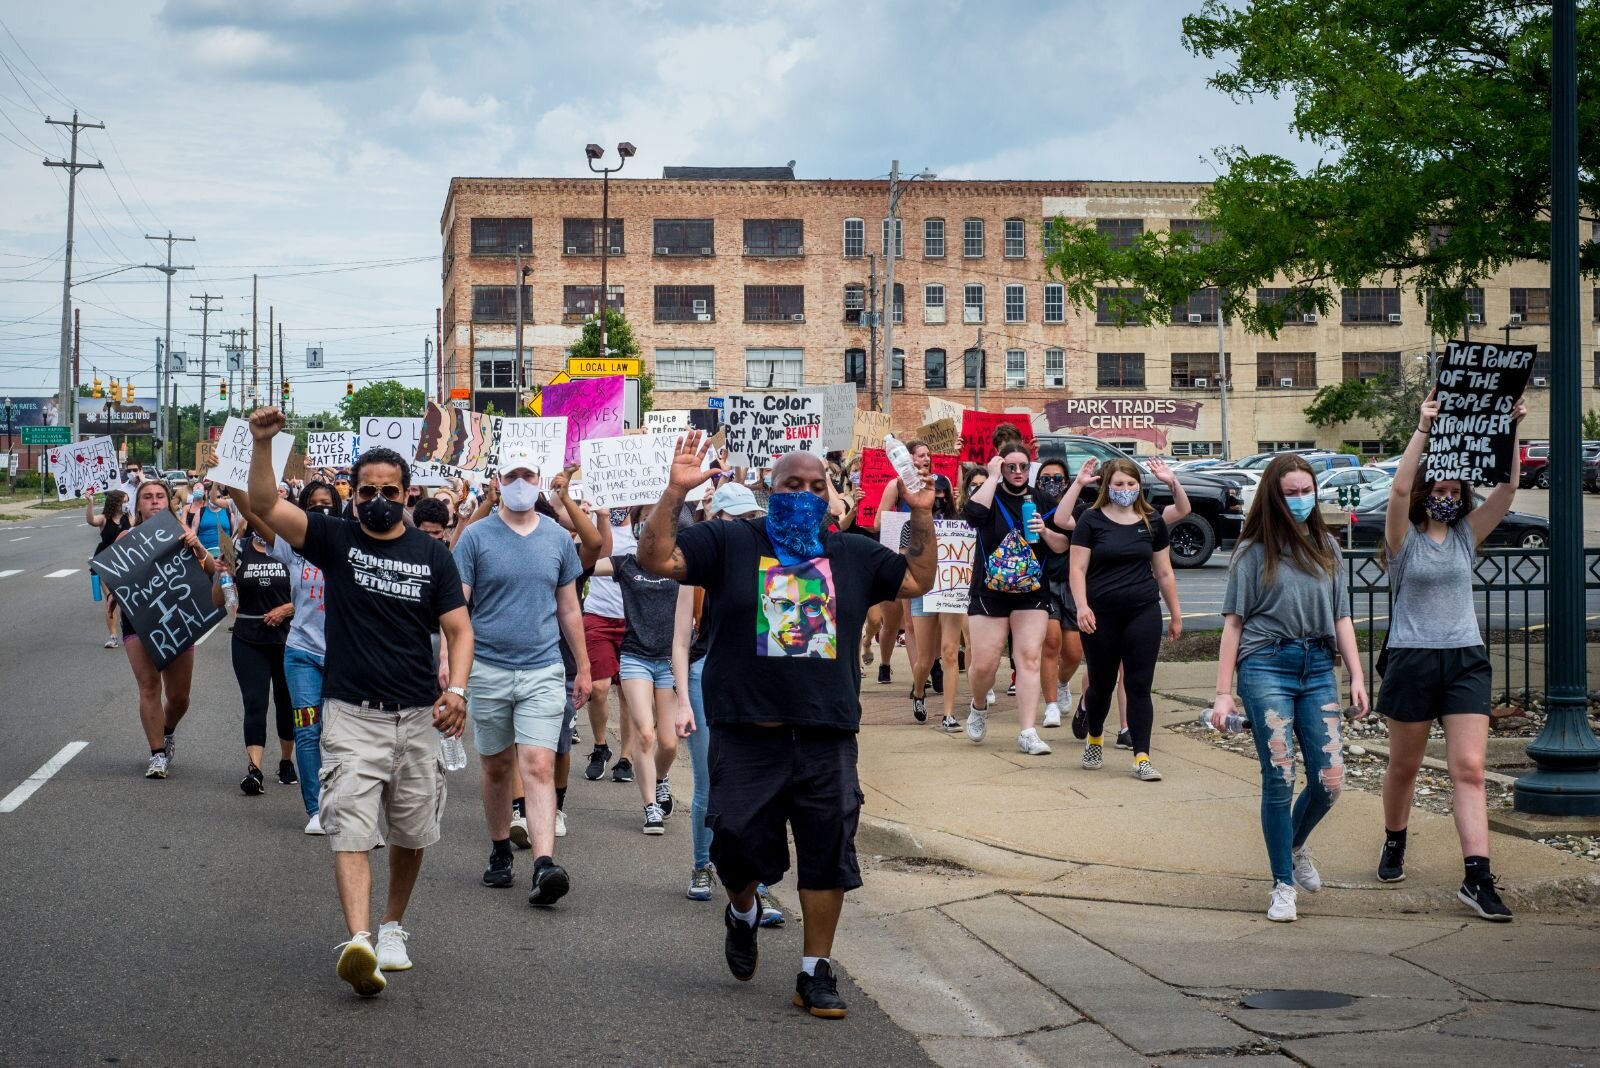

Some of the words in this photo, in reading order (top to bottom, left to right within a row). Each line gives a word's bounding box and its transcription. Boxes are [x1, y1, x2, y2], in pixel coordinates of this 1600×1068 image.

[1447, 342, 1482, 366] THE
[1482, 345, 1533, 369] POWER
[580, 363, 607, 372] LOCAL
[611, 363, 628, 372] LAW
[1439, 370, 1465, 388] OF
[1467, 371, 1501, 390] THE
[729, 395, 755, 409] The
[763, 395, 811, 411] Color
[1067, 399, 1108, 414] PARK
[1112, 399, 1176, 414] TRADES
[1437, 390, 1493, 412] PEOPLE
[1495, 395, 1514, 413] IS
[100, 411, 120, 419] INSIRE
[121, 411, 133, 419] KIDS
[135, 411, 142, 419] TO
[142, 411, 150, 419] DO
[594, 408, 619, 422] VES
[648, 414, 676, 424] police
[730, 411, 748, 425] Of
[750, 411, 779, 425] Your
[782, 412, 807, 427] Skin
[807, 413, 821, 425] Is
[857, 410, 891, 428] RACISM
[1088, 415, 1155, 429] CENTER
[366, 418, 420, 441] COL
[507, 422, 562, 439] JUSTICE
[725, 424, 746, 439] Part
[751, 426, 762, 440] Of
[765, 426, 785, 440] Your
[786, 424, 819, 440] BEAUTY
[868, 425, 877, 436] IS
[1431, 413, 1513, 435] STRONGER
[309, 432, 345, 443] BLACK
[591, 441, 604, 453] IF
[616, 438, 642, 452] YOU
[652, 435, 678, 448] ARE
[725, 438, 744, 452] Not
[747, 440, 753, 453] A
[757, 439, 796, 454] Measure
[799, 440, 812, 451] Of
[856, 434, 885, 451] TAUGH
[1429, 434, 1461, 452] THAN
[1464, 436, 1491, 452] THE
[309, 443, 344, 454] LIVES
[530, 440, 552, 453] THE
[311, 454, 351, 466] MATTER
[589, 453, 646, 470] NEUTRAL
[655, 451, 667, 464] IN
[746, 453, 770, 468] Your
[1427, 452, 1470, 469] PEOPLE
[1475, 454, 1496, 468] IN
[430, 465, 462, 480] #BLM
[587, 468, 637, 485] SITUATIONS
[642, 466, 655, 477] OF
[1425, 467, 1488, 482] POWER.
[589, 483, 603, 496] YOU
[607, 481, 629, 491] HAVE
[632, 476, 667, 488] CHOSEN
[596, 494, 608, 507] OF
[612, 492, 627, 503] THE
[630, 490, 663, 501] OPPRESSO
[946, 520, 959, 529] HIS
[93, 528, 173, 578] White
[937, 540, 977, 564] ONY
[247, 563, 283, 571] WESTERN
[348, 546, 431, 577] FATHERHOOD
[114, 547, 193, 616] Privelage
[243, 570, 287, 579] MICHIGAN
[354, 570, 422, 598] NETWORK
[148, 576, 192, 624] IS
[149, 598, 219, 660] REAL
